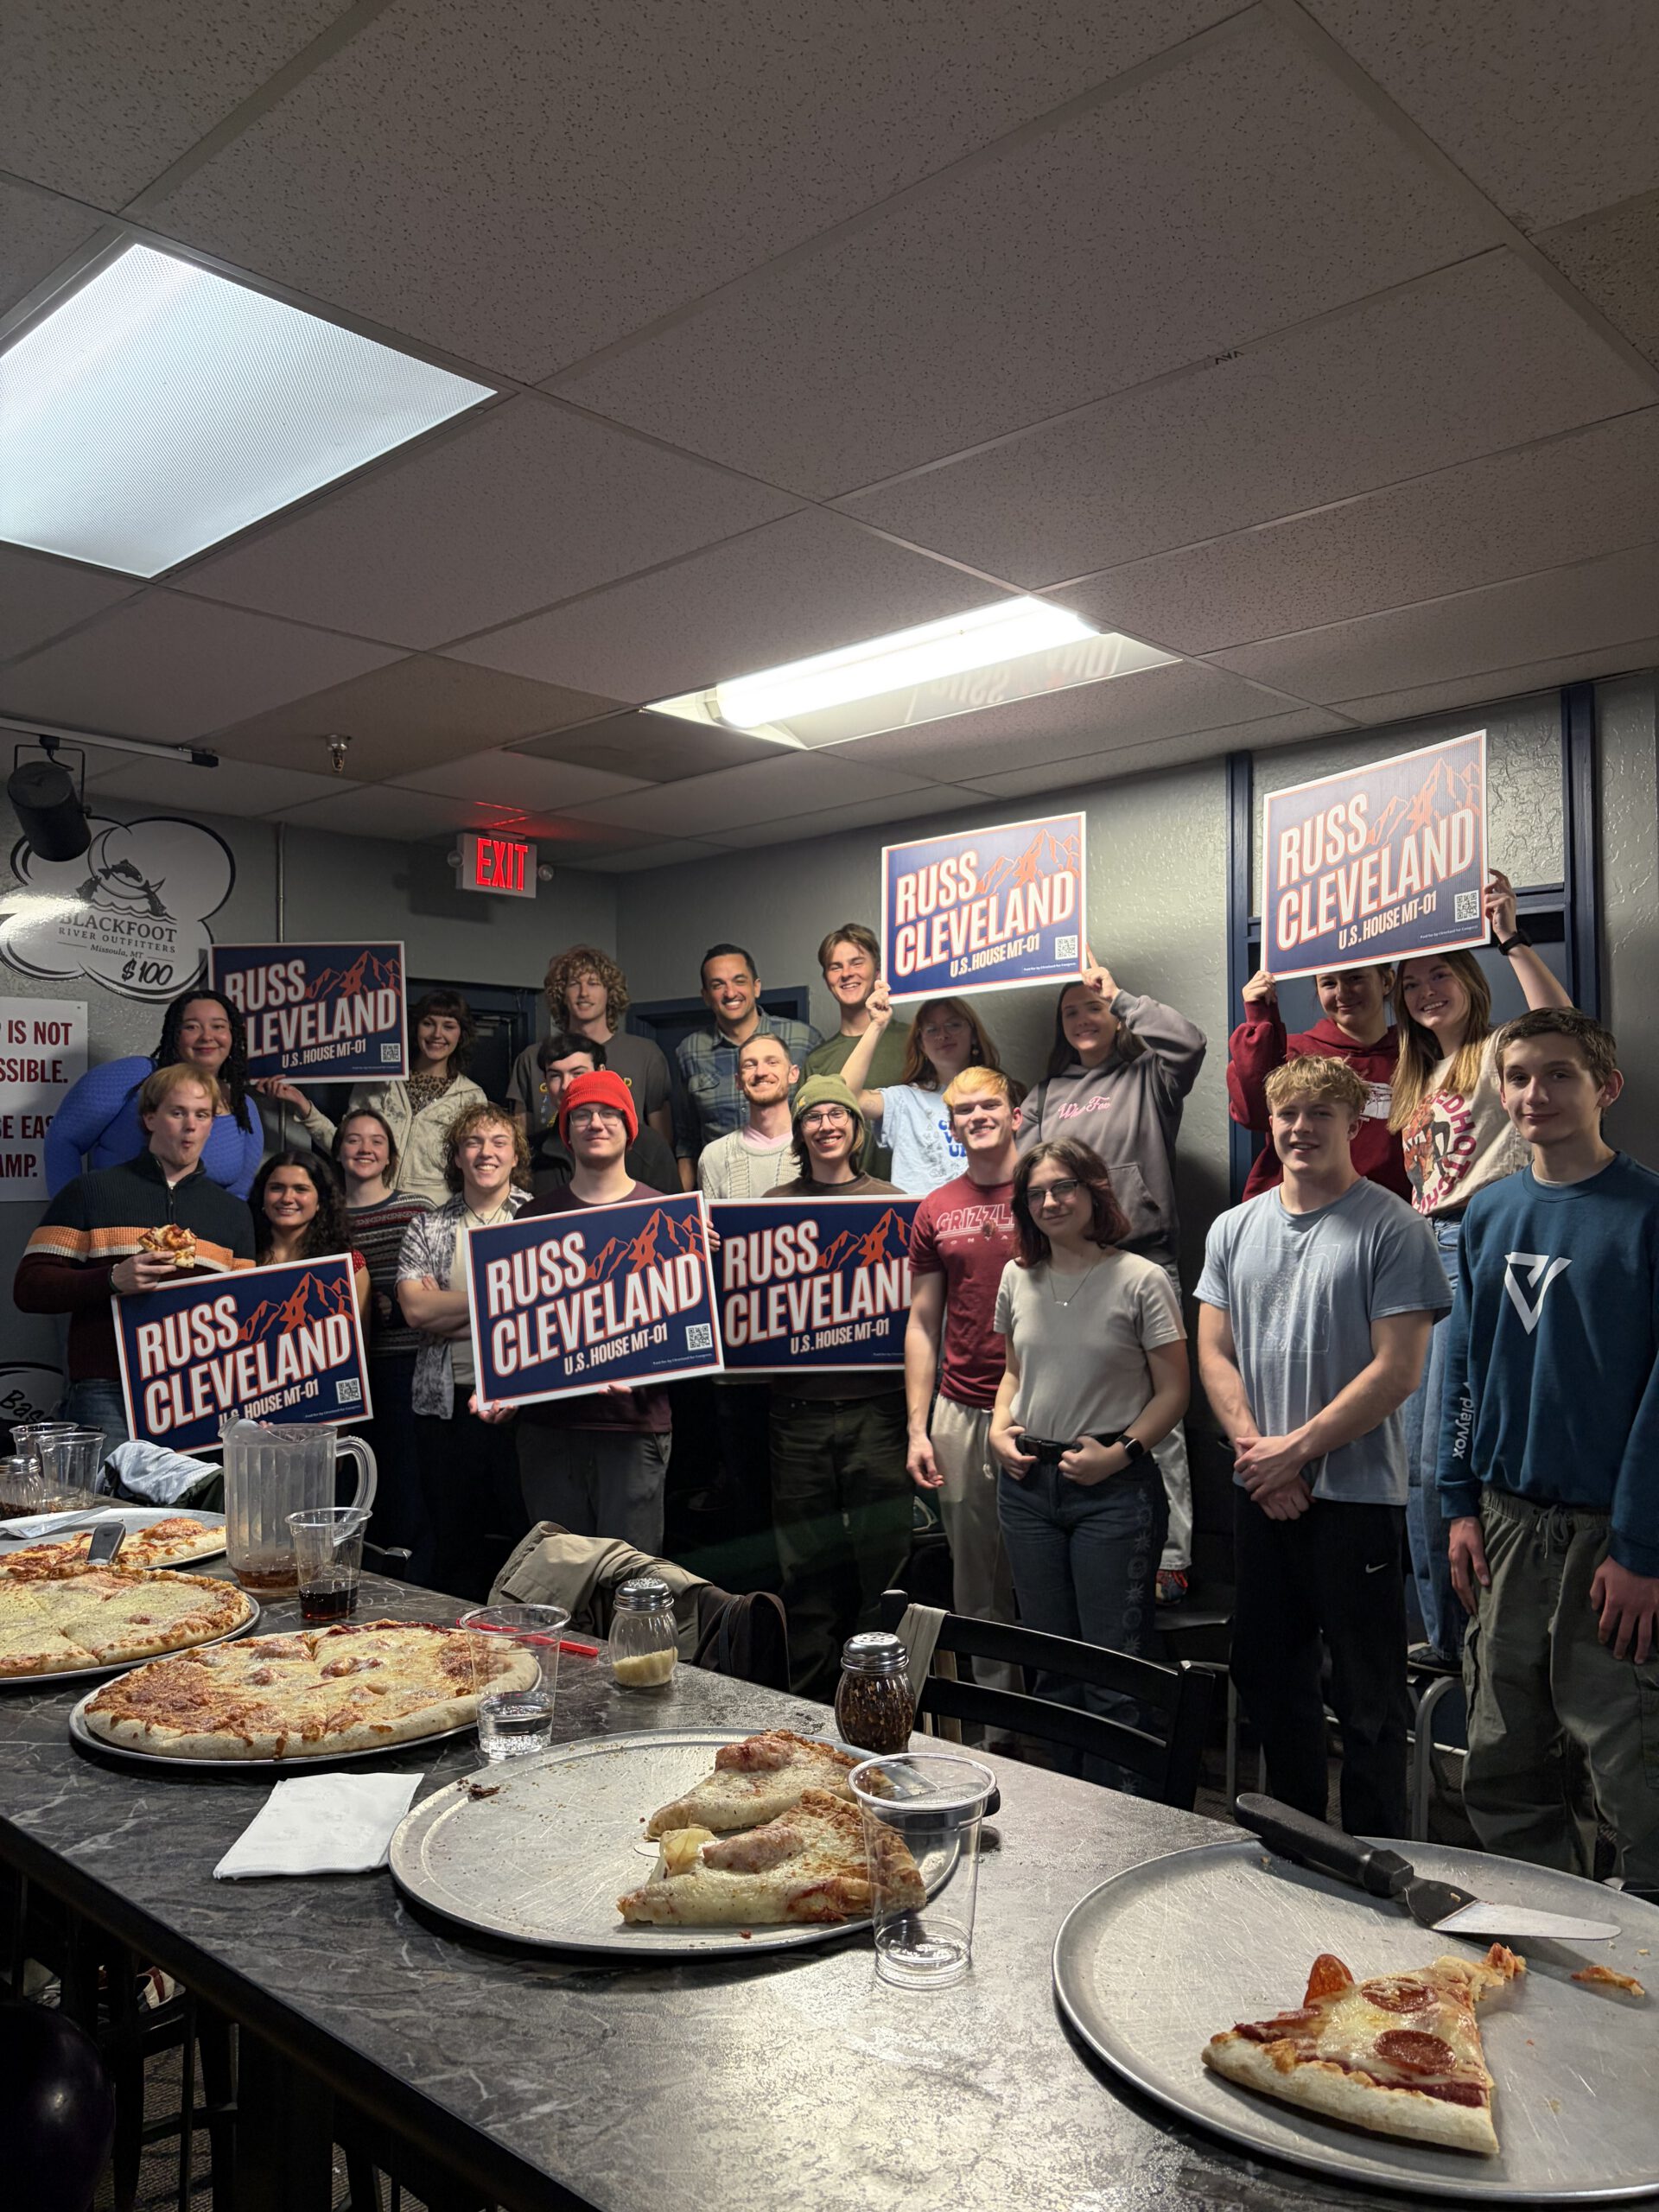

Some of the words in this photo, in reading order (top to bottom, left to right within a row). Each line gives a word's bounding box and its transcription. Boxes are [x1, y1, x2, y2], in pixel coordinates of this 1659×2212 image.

[476, 837, 528, 891] EXIT
[1278, 792, 1369, 889] RUSS
[895, 850, 977, 926] RUSS
[1276, 808, 1474, 950] CLEVELAND
[59, 927, 96, 940] RIVER
[102, 934, 175, 953] OUTFITTERS
[60, 912, 178, 943] BLACKFOOT
[895, 870, 1075, 977] CLEVELAND
[1338, 926, 1362, 950] U.S.
[1363, 907, 1400, 941] HOUSE
[1401, 890, 1437, 924] MT-01
[90, 944, 129, 957] Missoula,
[130, 950, 144, 959] MT
[122, 958, 174, 986] $100
[950, 957, 971, 977] U.S.
[971, 944, 1006, 970] HOUSE
[1007, 933, 1040, 959] MT-01
[225, 959, 306, 1013] RUSS
[8, 1020, 27, 1045] IS
[34, 1021, 73, 1046] NOT
[245, 988, 397, 1059] LEVELAND
[282, 1053, 302, 1068] U.S.
[303, 1044, 335, 1065] HOUSE
[336, 1039, 366, 1058] MT-01
[937, 1204, 1014, 1233] GRIZZL
[486, 1231, 588, 1319] RUSS
[723, 1219, 819, 1291] RUSS
[137, 1294, 238, 1380] RUSS
[492, 1252, 702, 1377] CLEVELAND
[791, 1336, 814, 1354] U.S.
[816, 1325, 853, 1349] HOUSE
[855, 1318, 889, 1339] MT-01
[144, 1314, 352, 1435] CLEVELAND
[564, 1355, 589, 1376] U.S.
[590, 1339, 629, 1366] HOUSE
[632, 1323, 668, 1351] MT-01
[244, 1395, 283, 1419] HOUSE
[283, 1379, 319, 1408] MT-01
[1452, 1396, 1475, 1459] playvox
